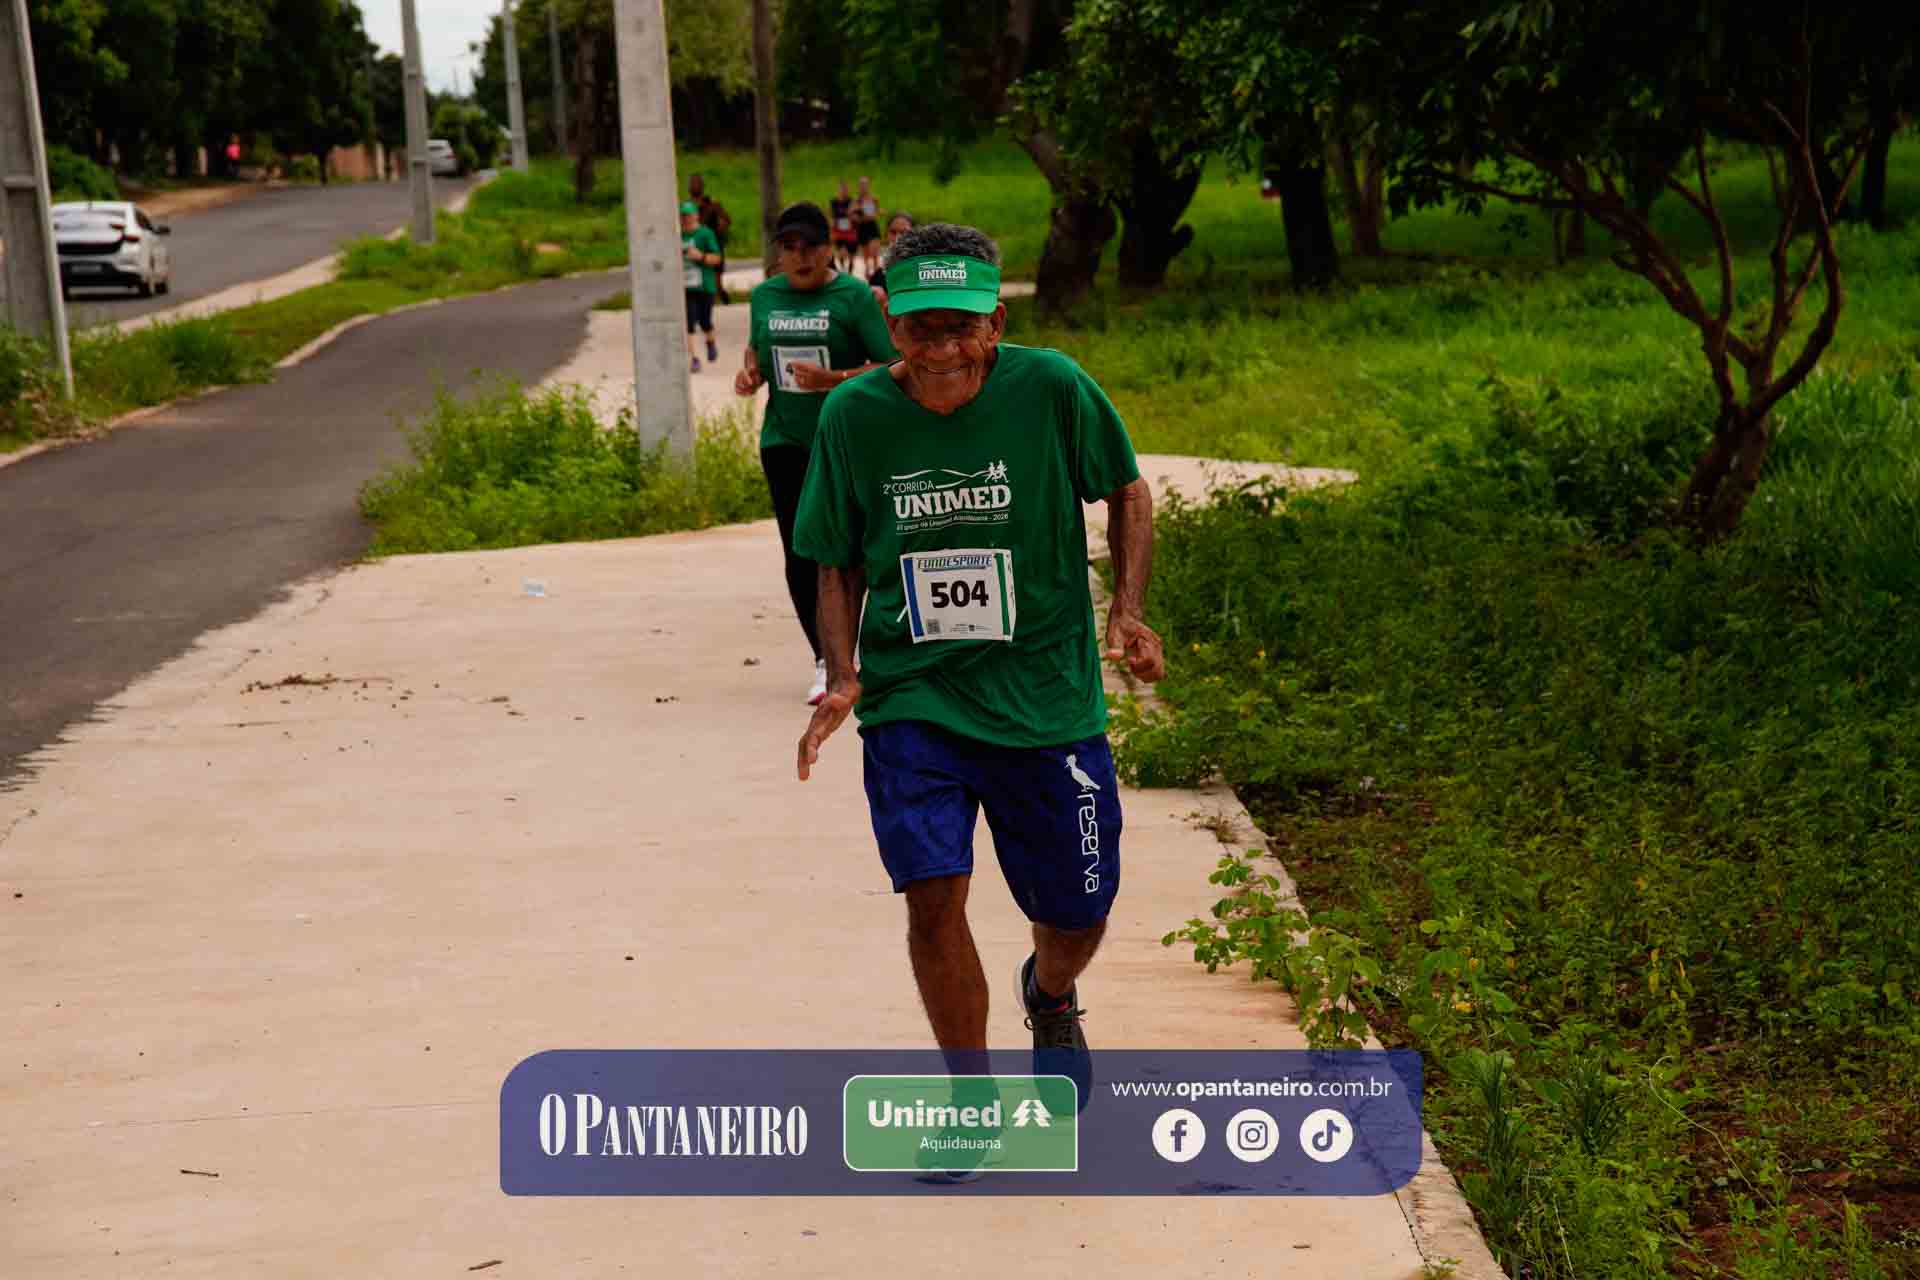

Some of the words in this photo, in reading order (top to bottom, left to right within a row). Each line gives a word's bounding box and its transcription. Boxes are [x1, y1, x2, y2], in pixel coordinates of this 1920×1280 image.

[919, 269, 967, 280] UNIMED
[768, 319, 830, 331] UNIMED
[891, 480, 935, 494] CORRIDA
[893, 484, 1012, 518] UNIMED
[930, 580, 990, 609] 504
[1077, 793, 1100, 894] reserva
